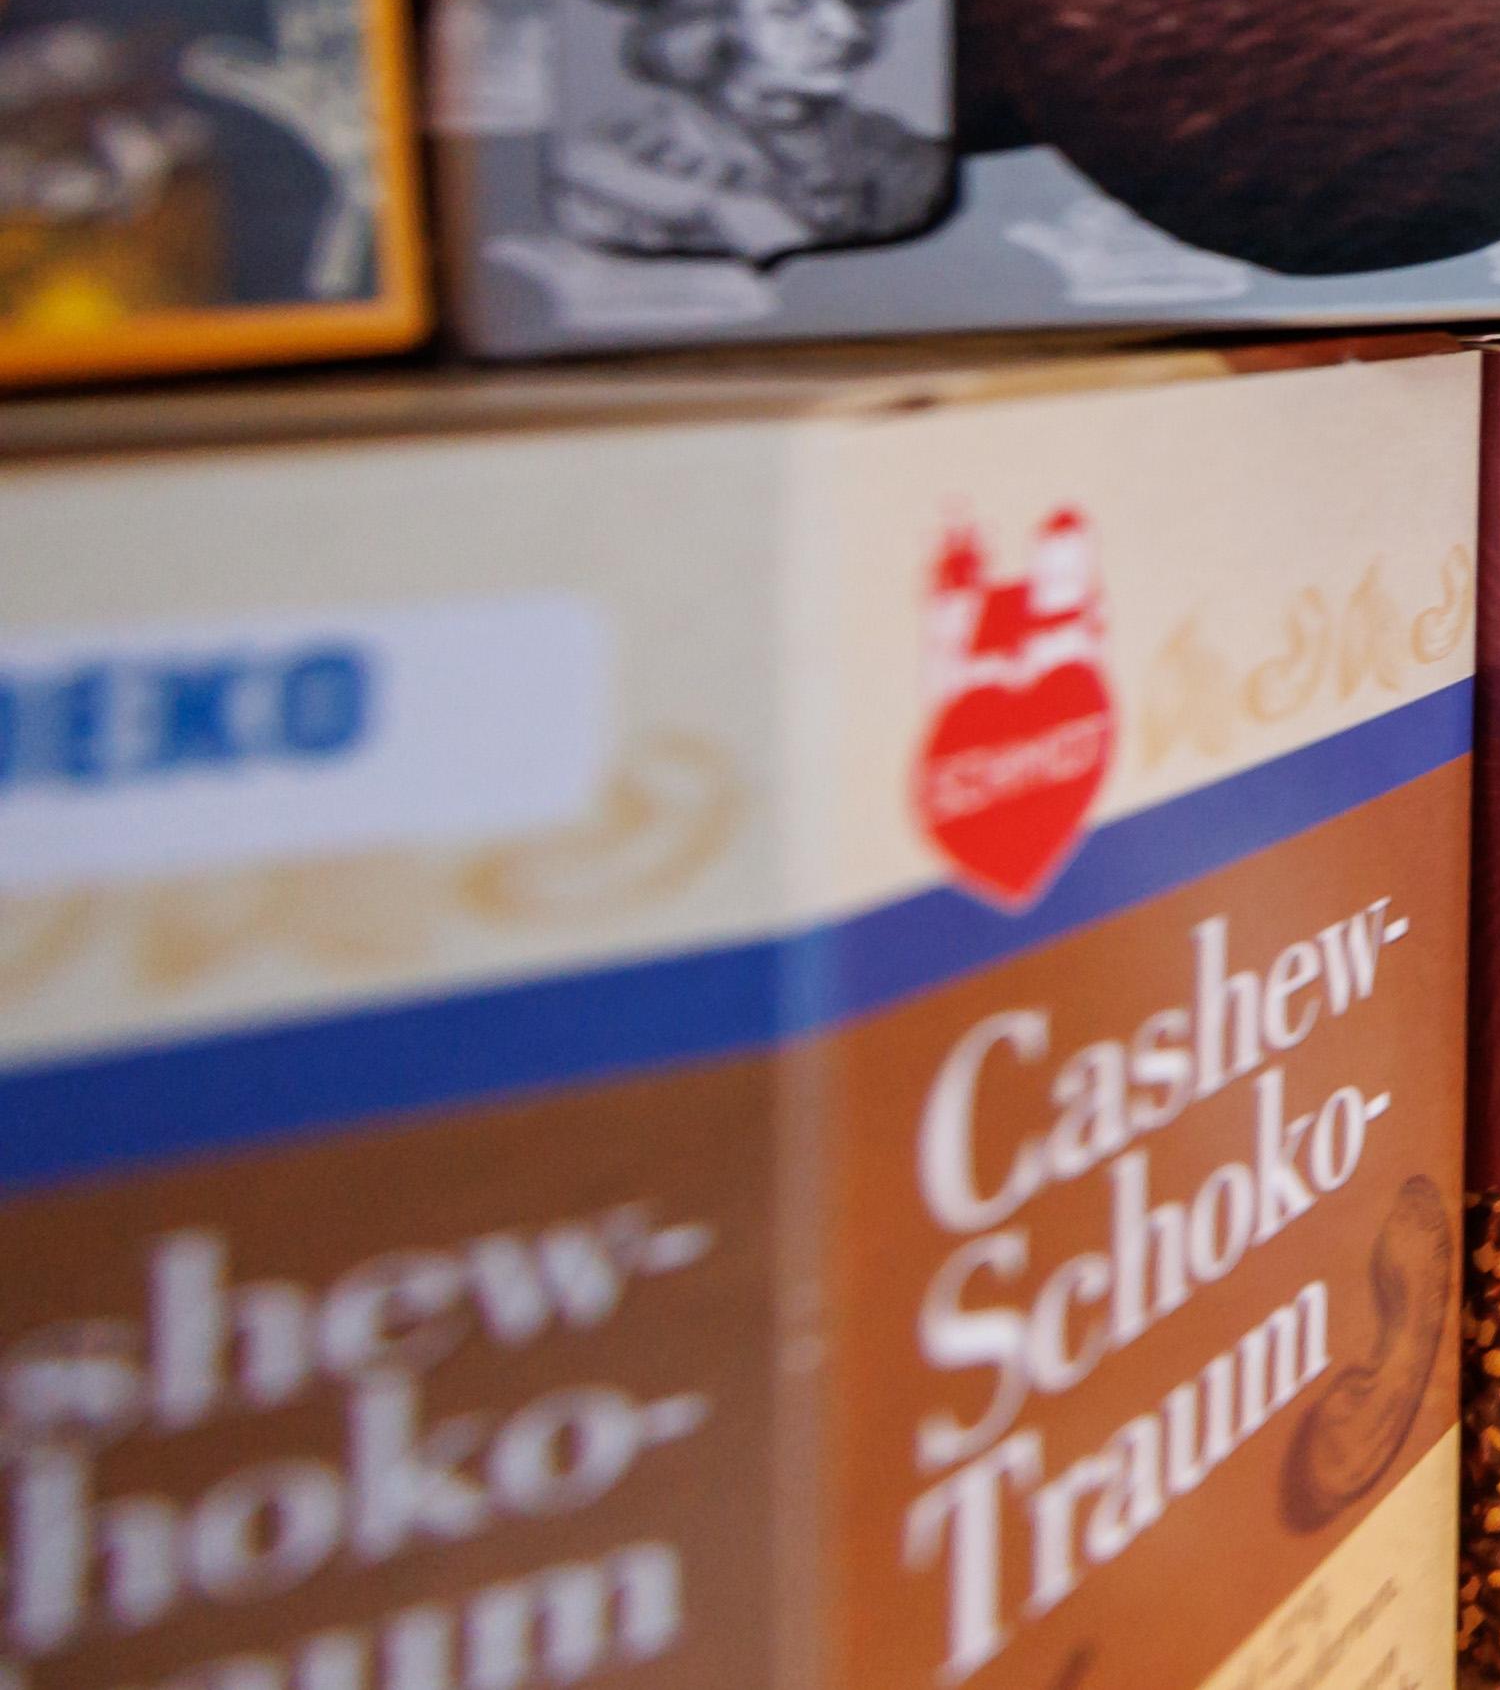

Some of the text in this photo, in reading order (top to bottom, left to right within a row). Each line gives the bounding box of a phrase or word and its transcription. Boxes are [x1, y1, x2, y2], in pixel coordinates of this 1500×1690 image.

[916, 896, 1409, 1233] Cashew-
[912, 1066, 1390, 1475] Schoko-
[901, 1279, 1332, 1688] Traum
